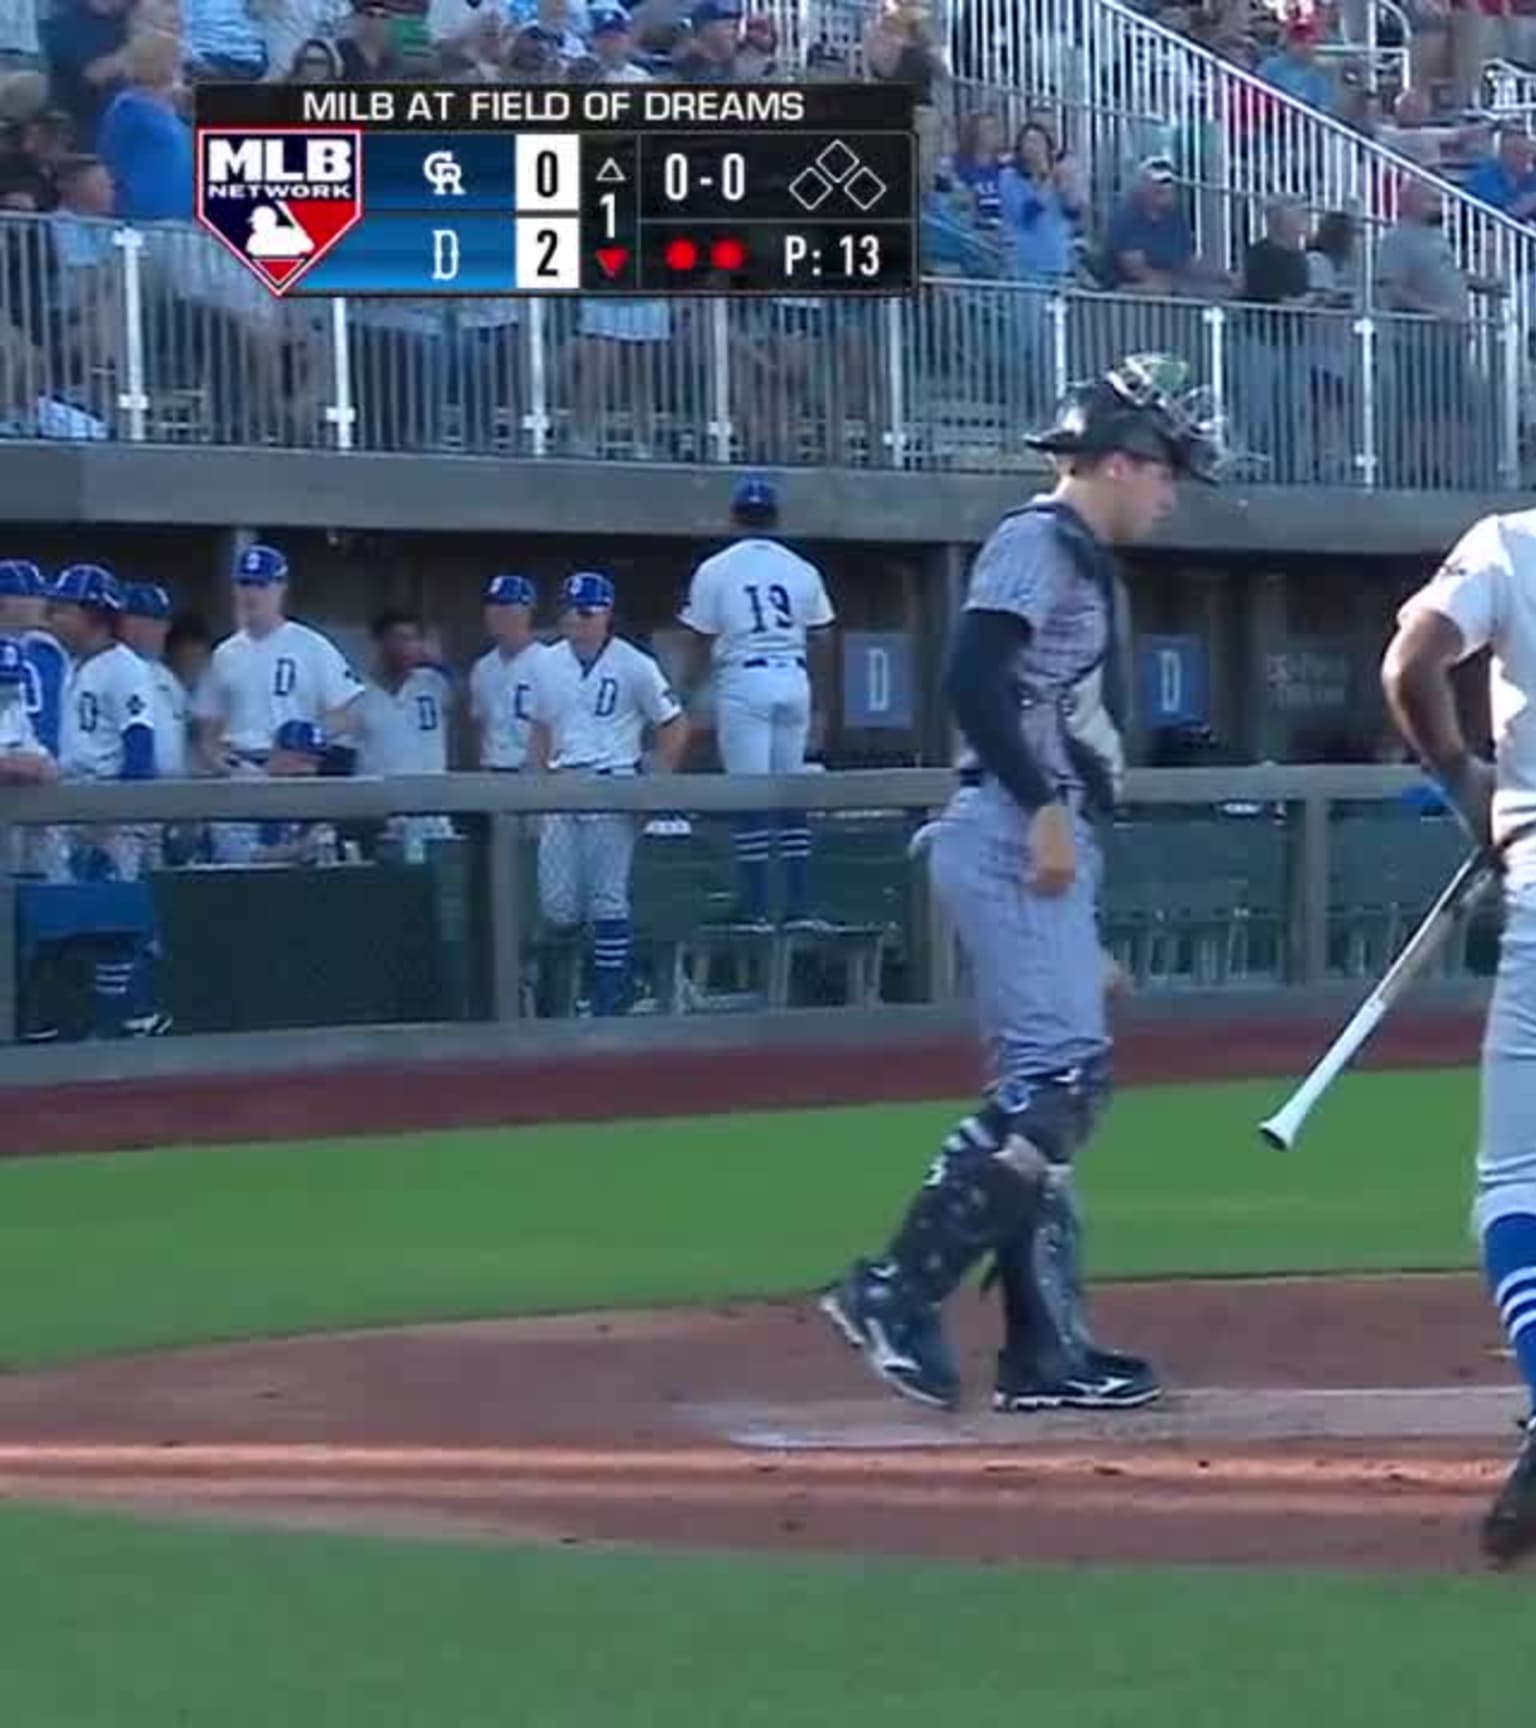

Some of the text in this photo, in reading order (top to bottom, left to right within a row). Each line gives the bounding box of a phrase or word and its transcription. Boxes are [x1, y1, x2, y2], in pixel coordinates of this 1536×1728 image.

[744, 583, 794, 634] 19
[274, 657, 297, 697] D
[595, 677, 619, 718] D
[868, 647, 890, 712] D
[1159, 650, 1183, 712] D
[78, 690, 99, 733] D
[416, 695, 438, 731] D
